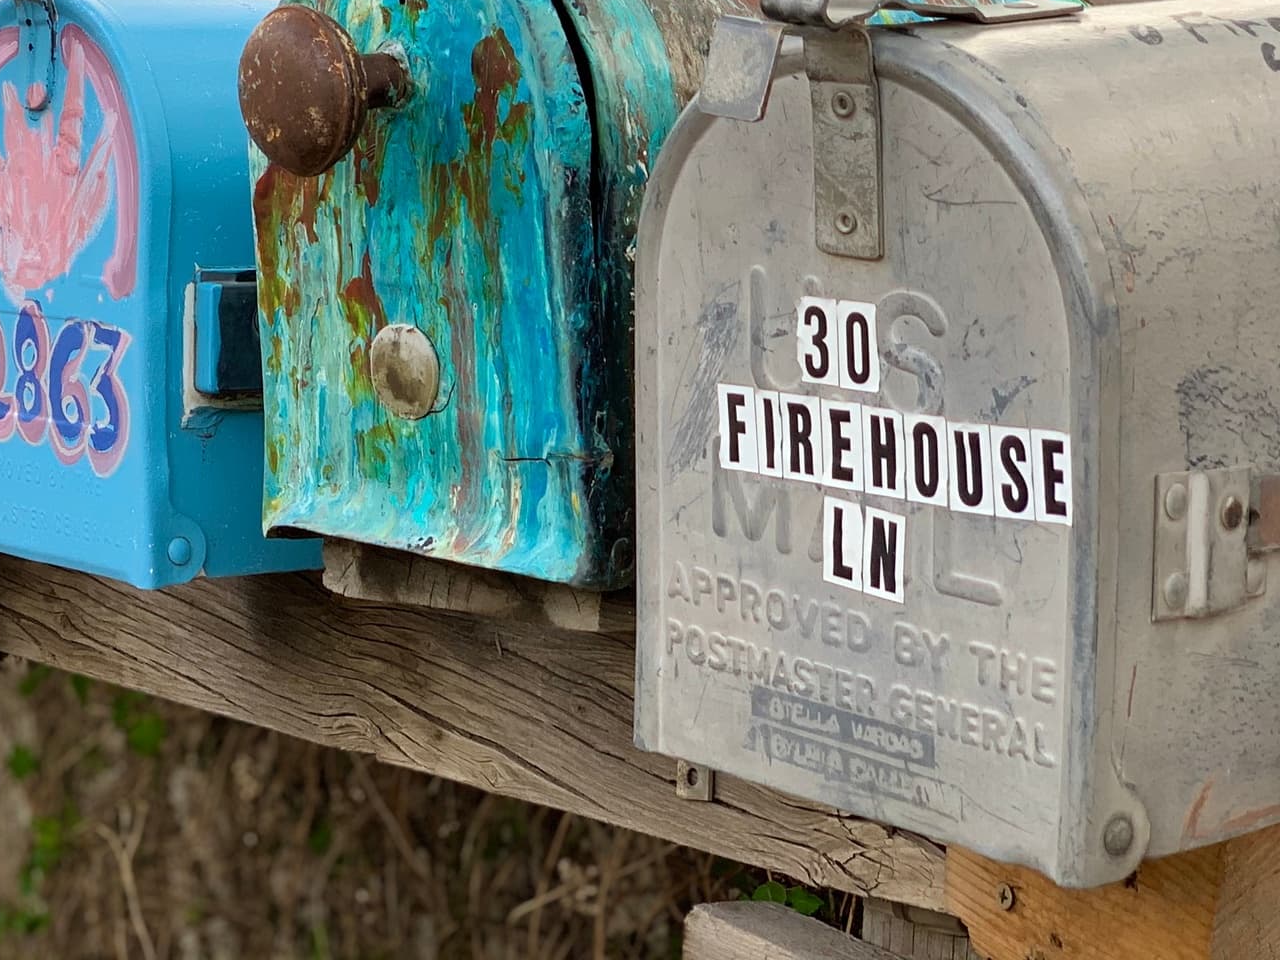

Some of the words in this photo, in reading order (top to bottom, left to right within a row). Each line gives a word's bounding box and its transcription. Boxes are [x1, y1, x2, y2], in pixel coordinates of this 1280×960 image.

[804, 305, 871, 384] 30
[726, 392, 1068, 517] FIREHOUSE
[832, 506, 898, 595] LN
[665, 560, 873, 654] APPROVED
[893, 620, 949, 674] BY
[968, 640, 1058, 704] THE
[665, 616, 875, 717] POSTMASTER
[887, 683, 1059, 770] GENERAL
